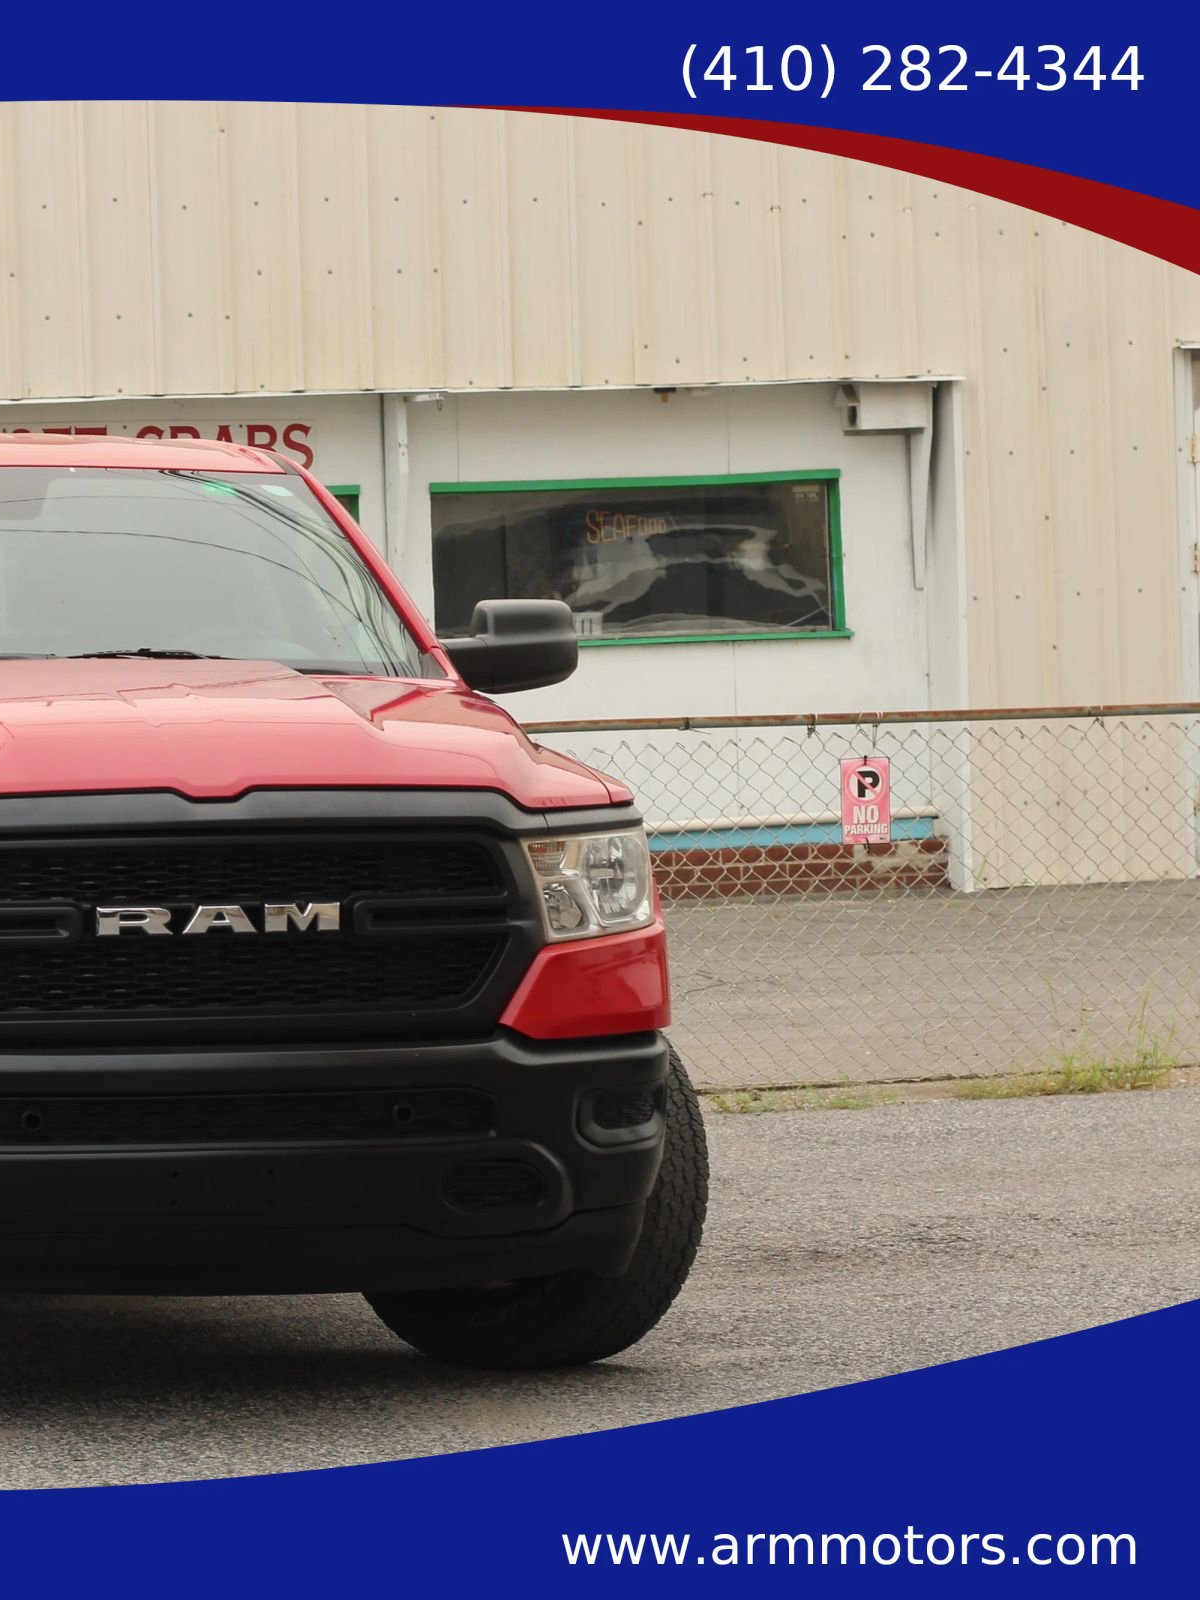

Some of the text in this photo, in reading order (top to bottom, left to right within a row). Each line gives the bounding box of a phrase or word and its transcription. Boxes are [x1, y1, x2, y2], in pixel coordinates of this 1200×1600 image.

[853, 805, 879, 824] NO
[844, 823, 888, 835] PARKING
[96, 902, 340, 936] RAM
